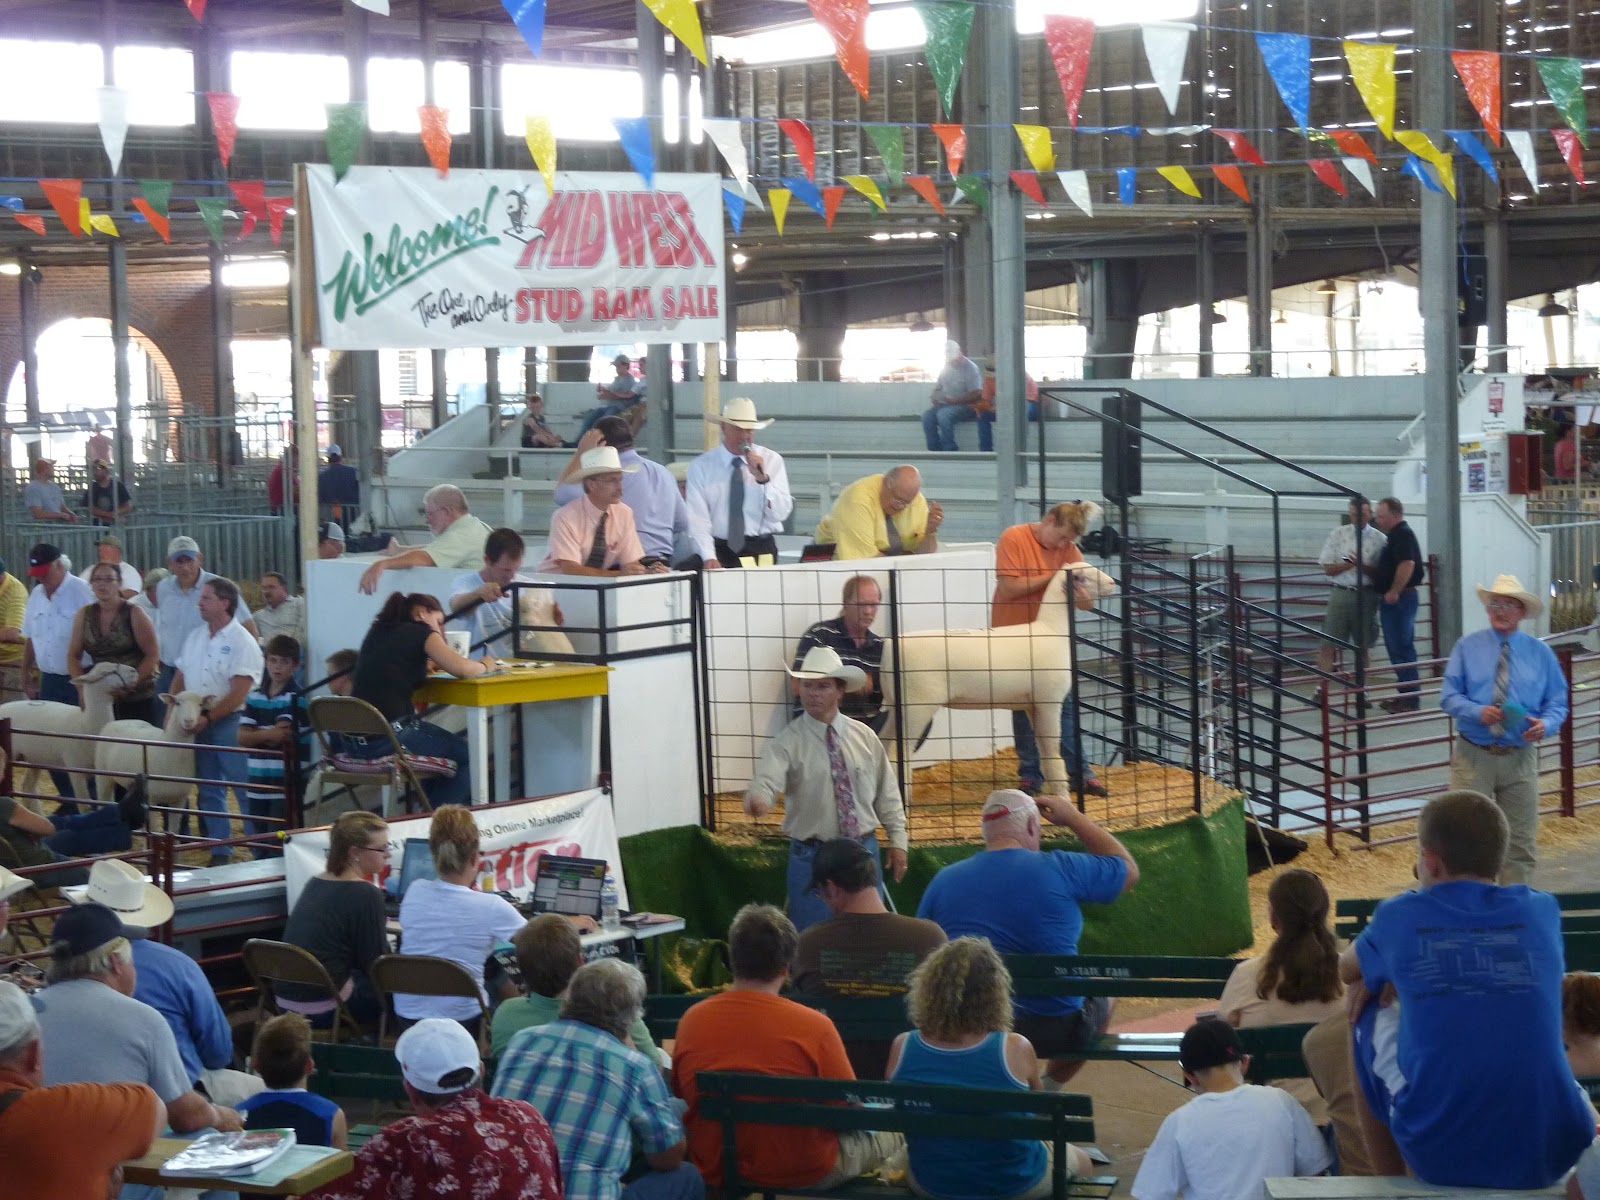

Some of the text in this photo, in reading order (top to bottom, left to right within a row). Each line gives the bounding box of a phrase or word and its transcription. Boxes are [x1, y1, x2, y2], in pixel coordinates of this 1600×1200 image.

[323, 185, 499, 322] Welcome!
[411, 287, 463, 328] The One
[451, 289, 513, 329] and Only
[514, 284, 719, 324] STUD RAM SALE
[493, 821, 527, 835] Online
[528, 807, 585, 829] Marketplace!
[1071, 966, 1101, 976] STATE
[1104, 966, 1131, 977] FAIR
